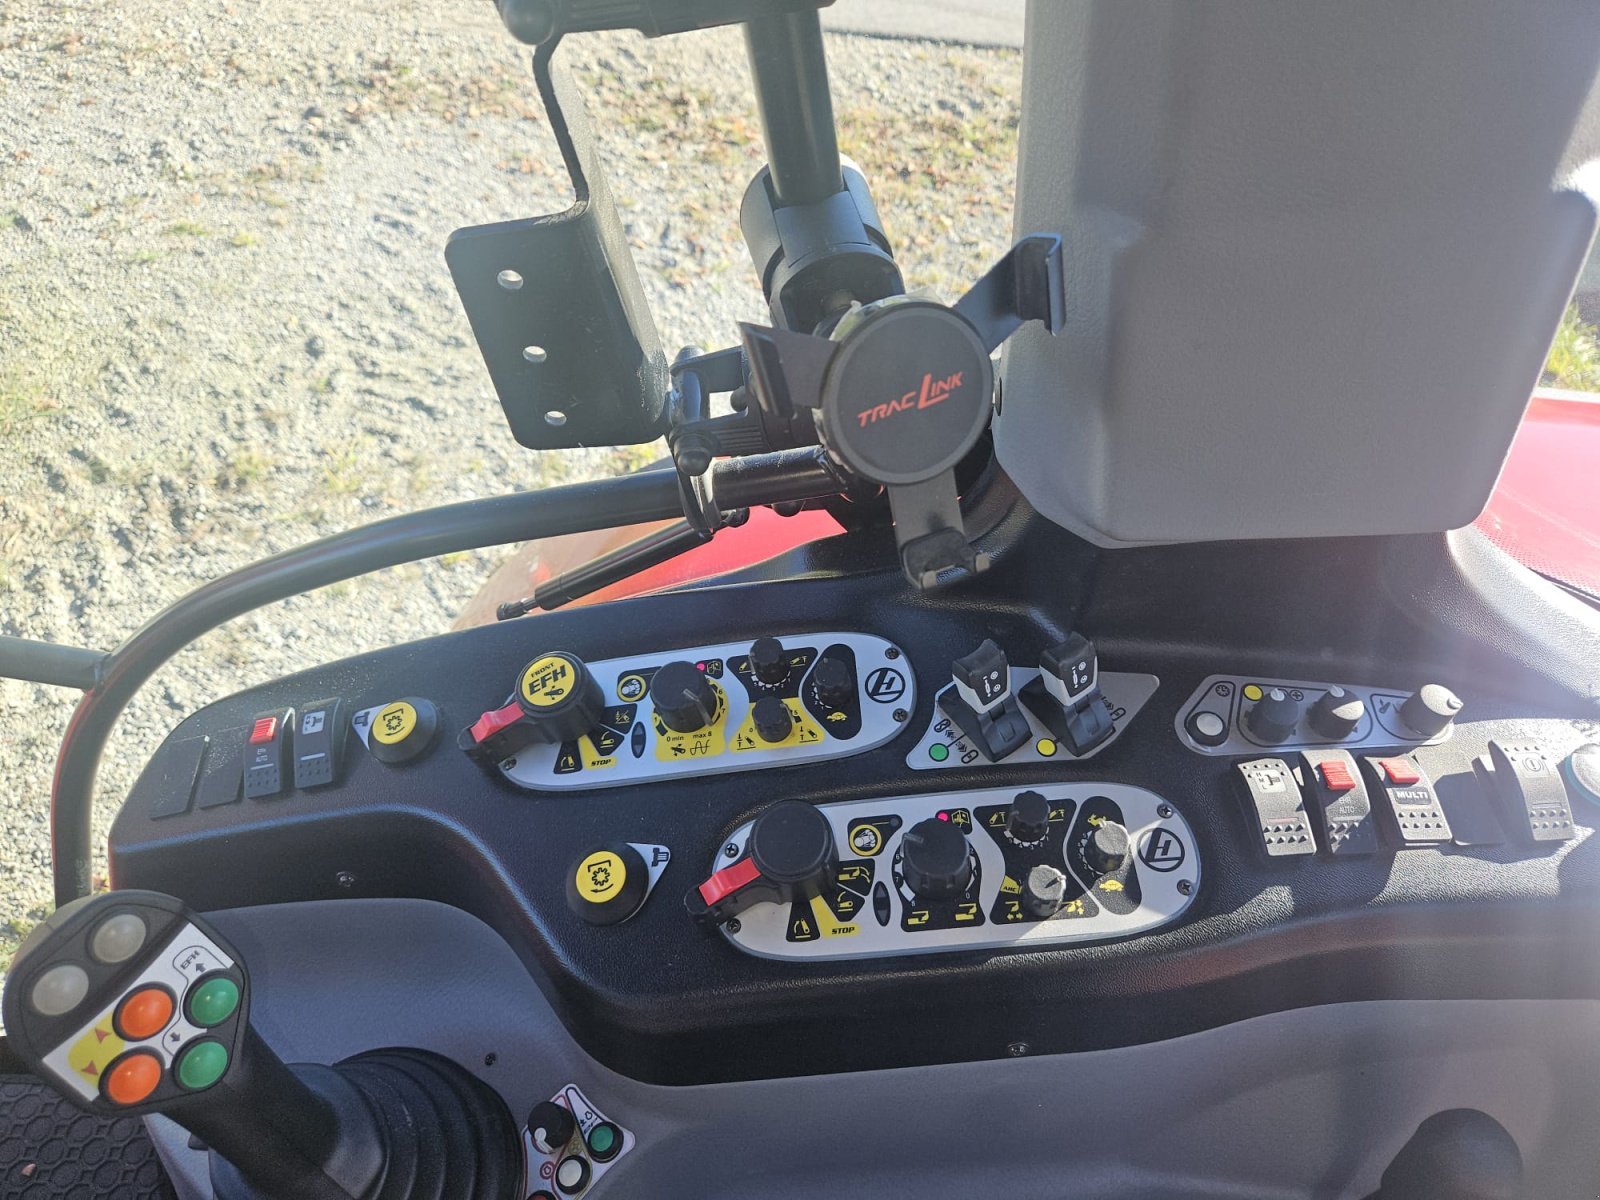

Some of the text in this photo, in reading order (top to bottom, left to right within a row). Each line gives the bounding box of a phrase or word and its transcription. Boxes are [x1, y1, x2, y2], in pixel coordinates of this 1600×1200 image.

[531, 662, 554, 678] FRONT
[528, 664, 567, 696] EFH
[591, 758, 612, 767] STOP
[1396, 791, 1428, 799] MULTI
[1340, 806, 1355, 814] AUTO
[831, 926, 856, 935] STOP
[180, 950, 200, 970] EFH
